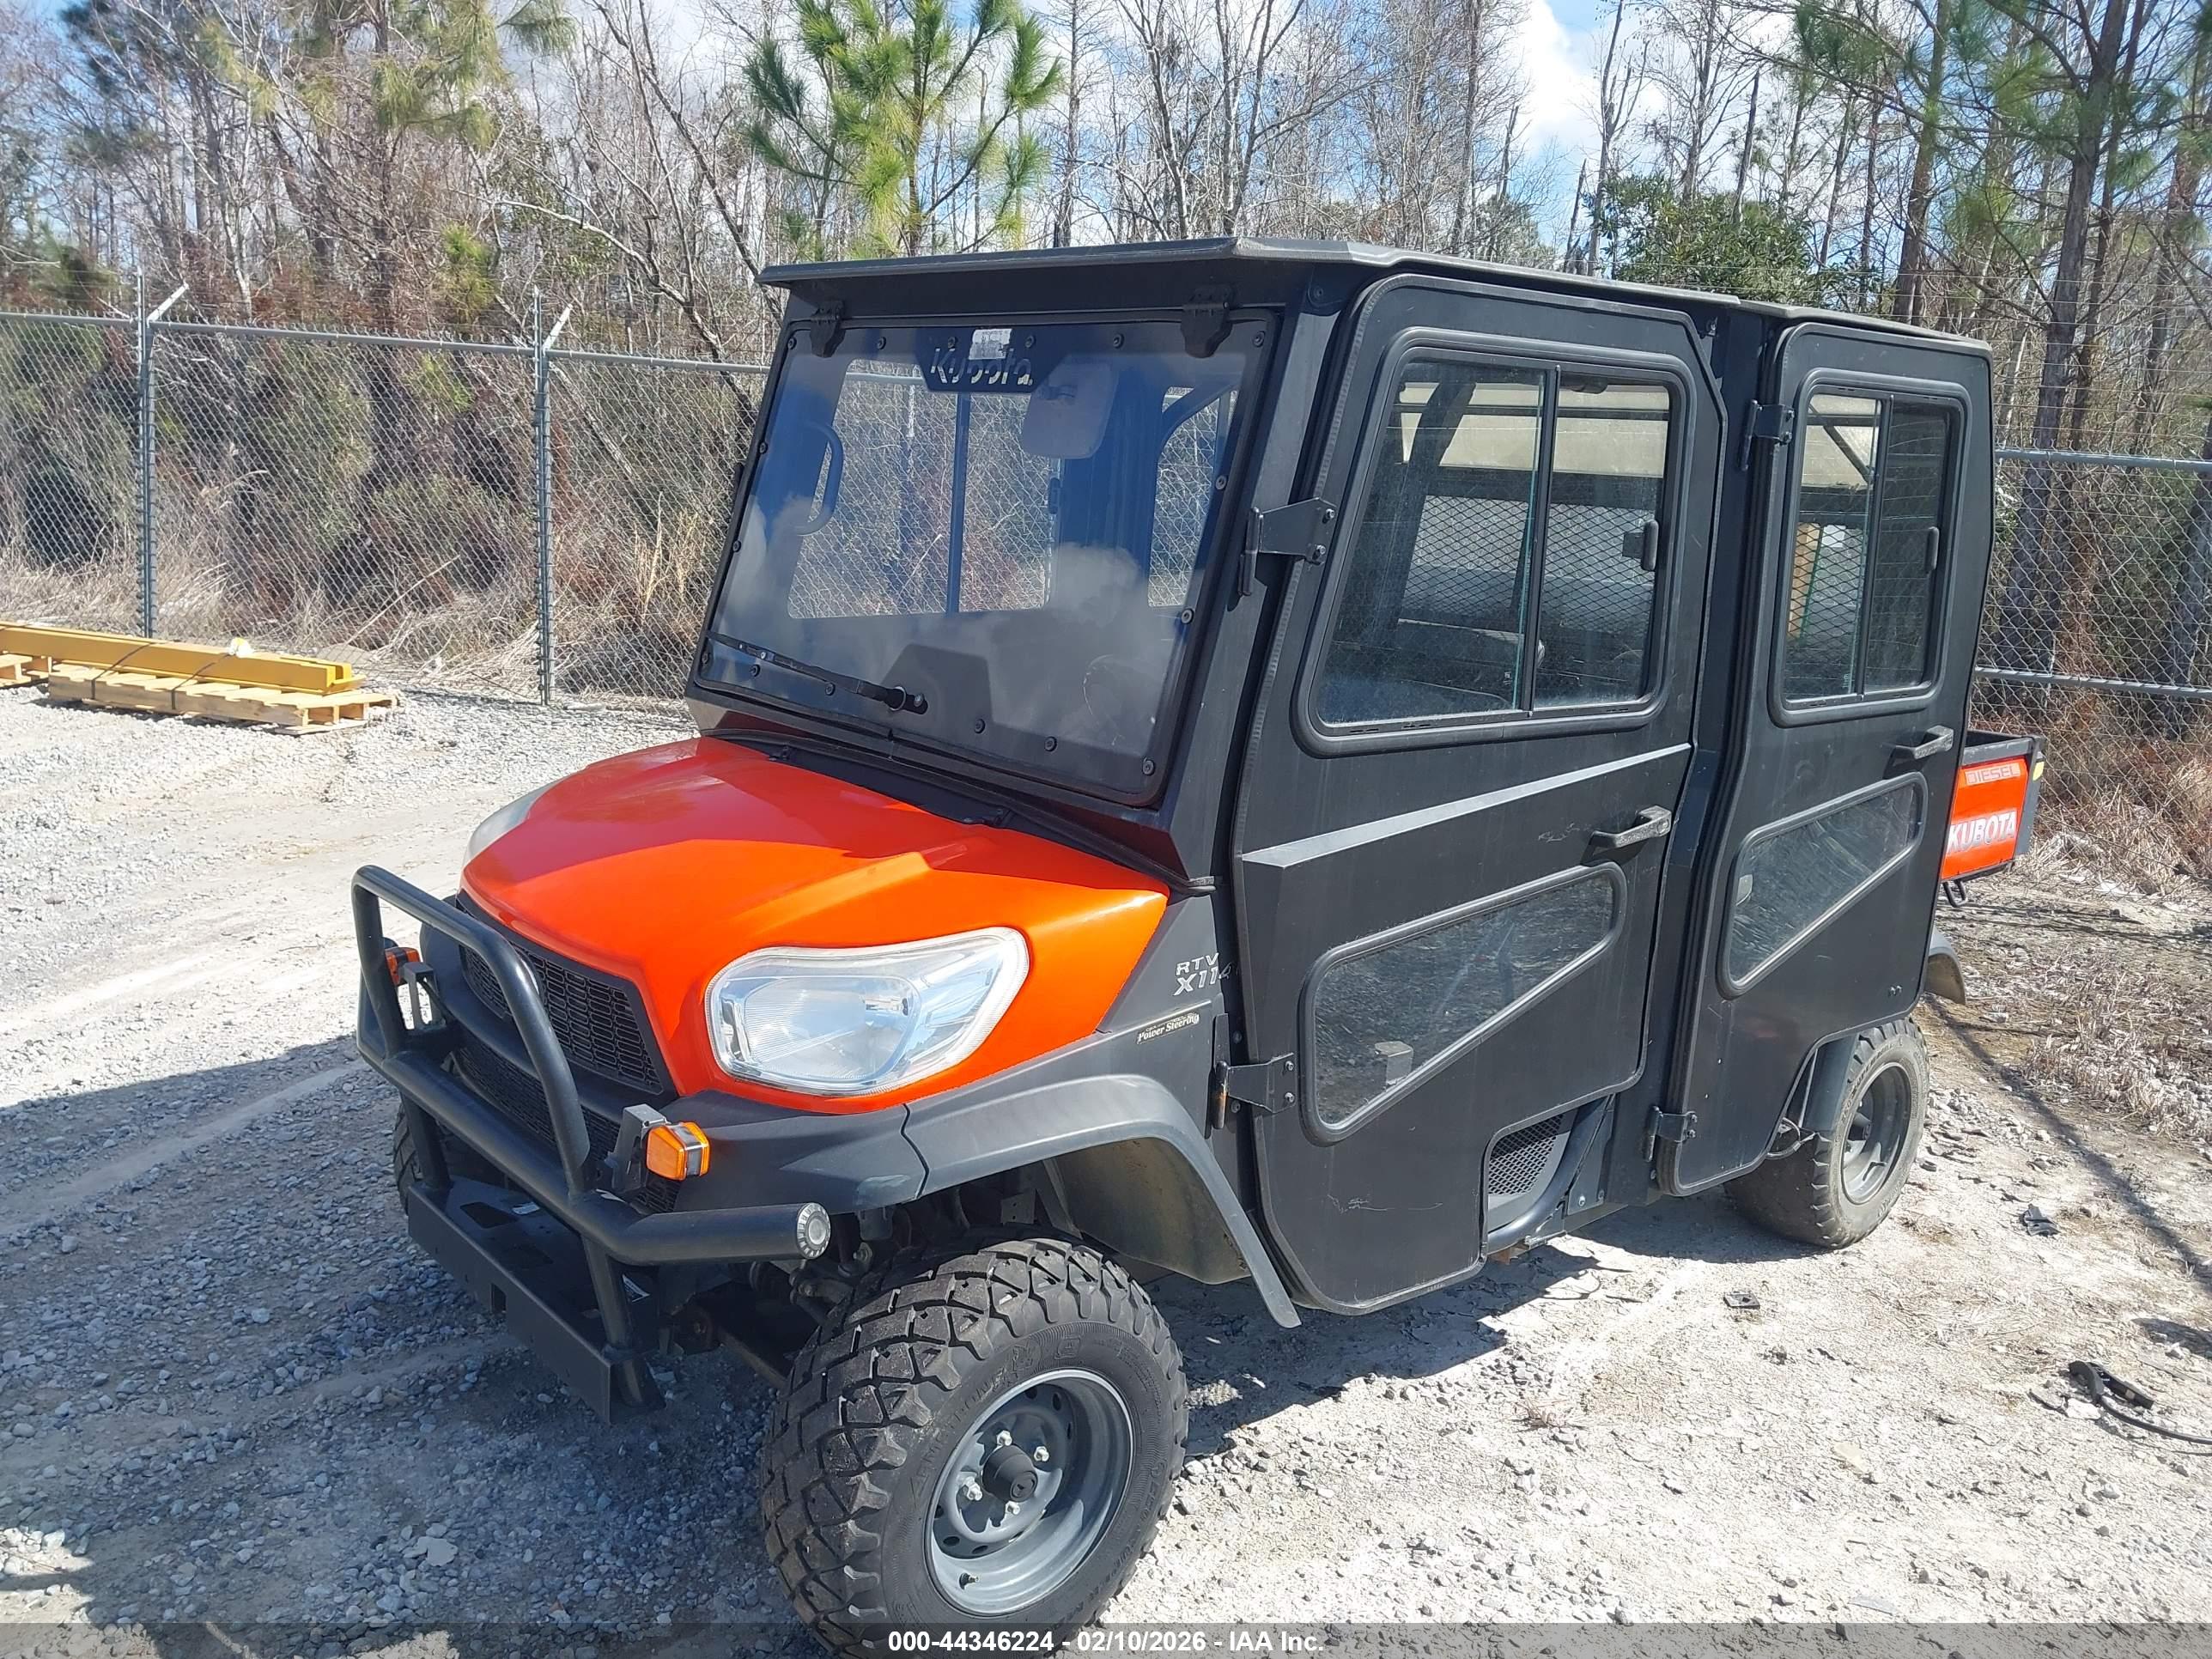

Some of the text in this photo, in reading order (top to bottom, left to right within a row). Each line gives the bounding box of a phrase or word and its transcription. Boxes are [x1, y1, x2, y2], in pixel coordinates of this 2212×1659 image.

[930, 347, 1032, 386] Kubota
[1966, 765, 2020, 783] DIESEL
[1947, 810, 2017, 853] KUBOTA
[1176, 952, 1219, 975] RTV
[1136, 1026, 1165, 1043] Power
[1165, 1013, 1200, 1032] Steering
